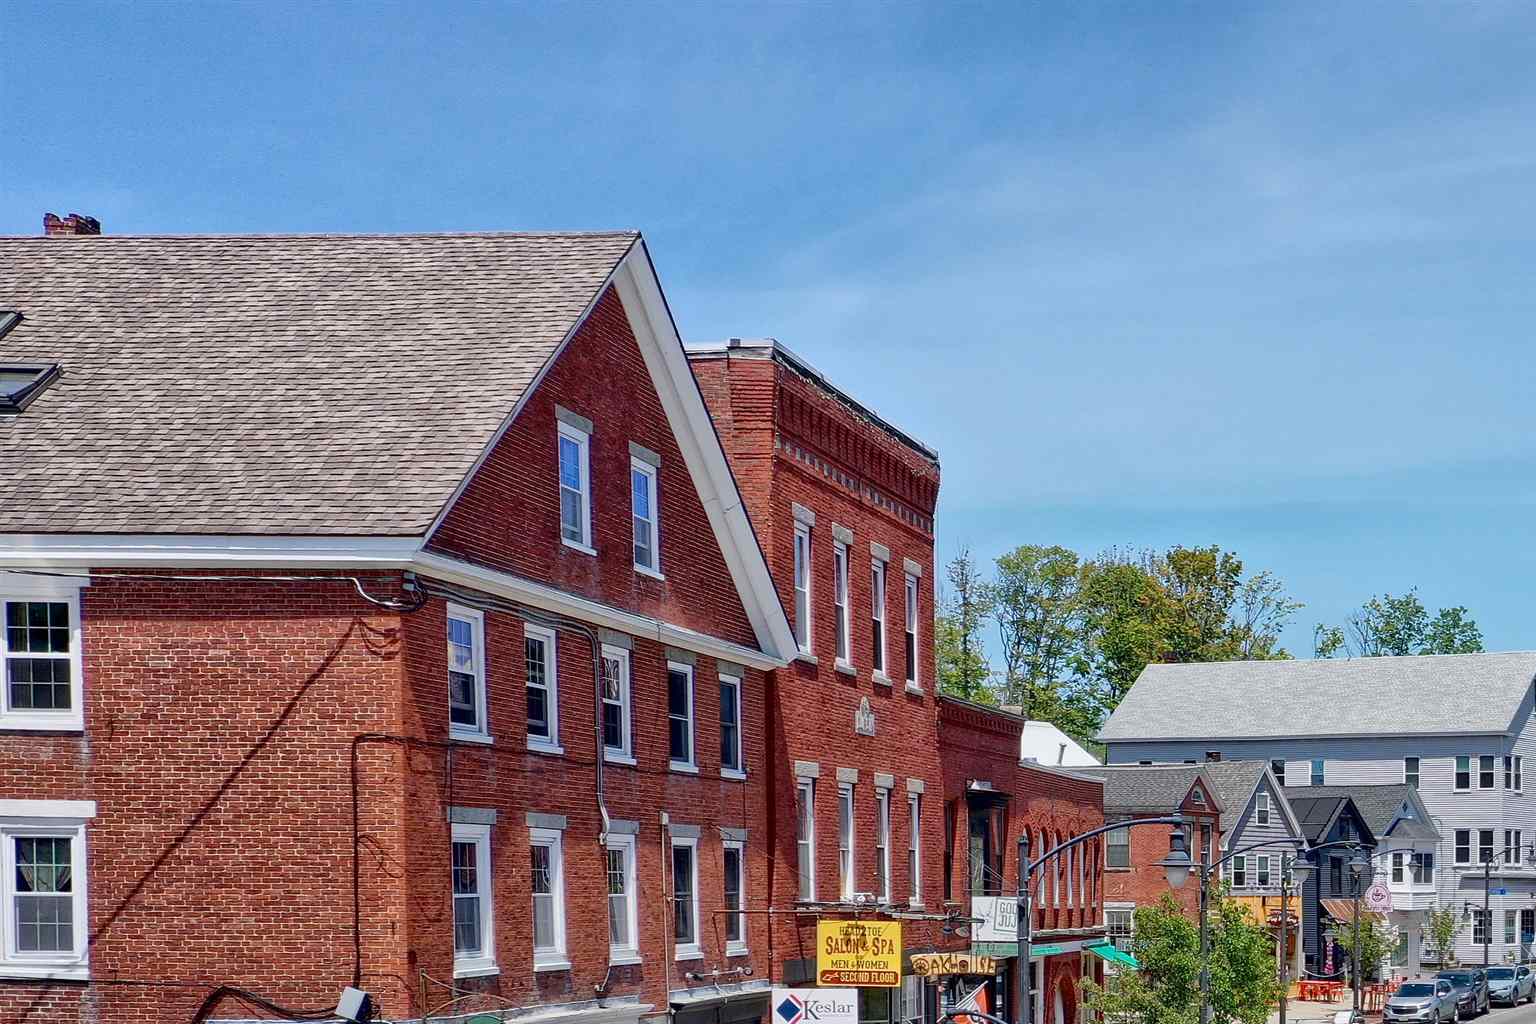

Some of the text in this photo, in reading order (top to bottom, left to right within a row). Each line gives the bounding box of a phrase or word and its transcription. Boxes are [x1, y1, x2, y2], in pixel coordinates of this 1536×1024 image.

[998, 915, 1017, 928] JUJ
[867, 926, 882, 937] TOE
[825, 936, 860, 955] SALON
[872, 937, 894, 956] SPA
[831, 960, 849, 969] MEN
[857, 960, 889, 970] WOMEN
[840, 971, 895, 983] SECOND FLOOR
[802, 999, 854, 1020] Keslar
